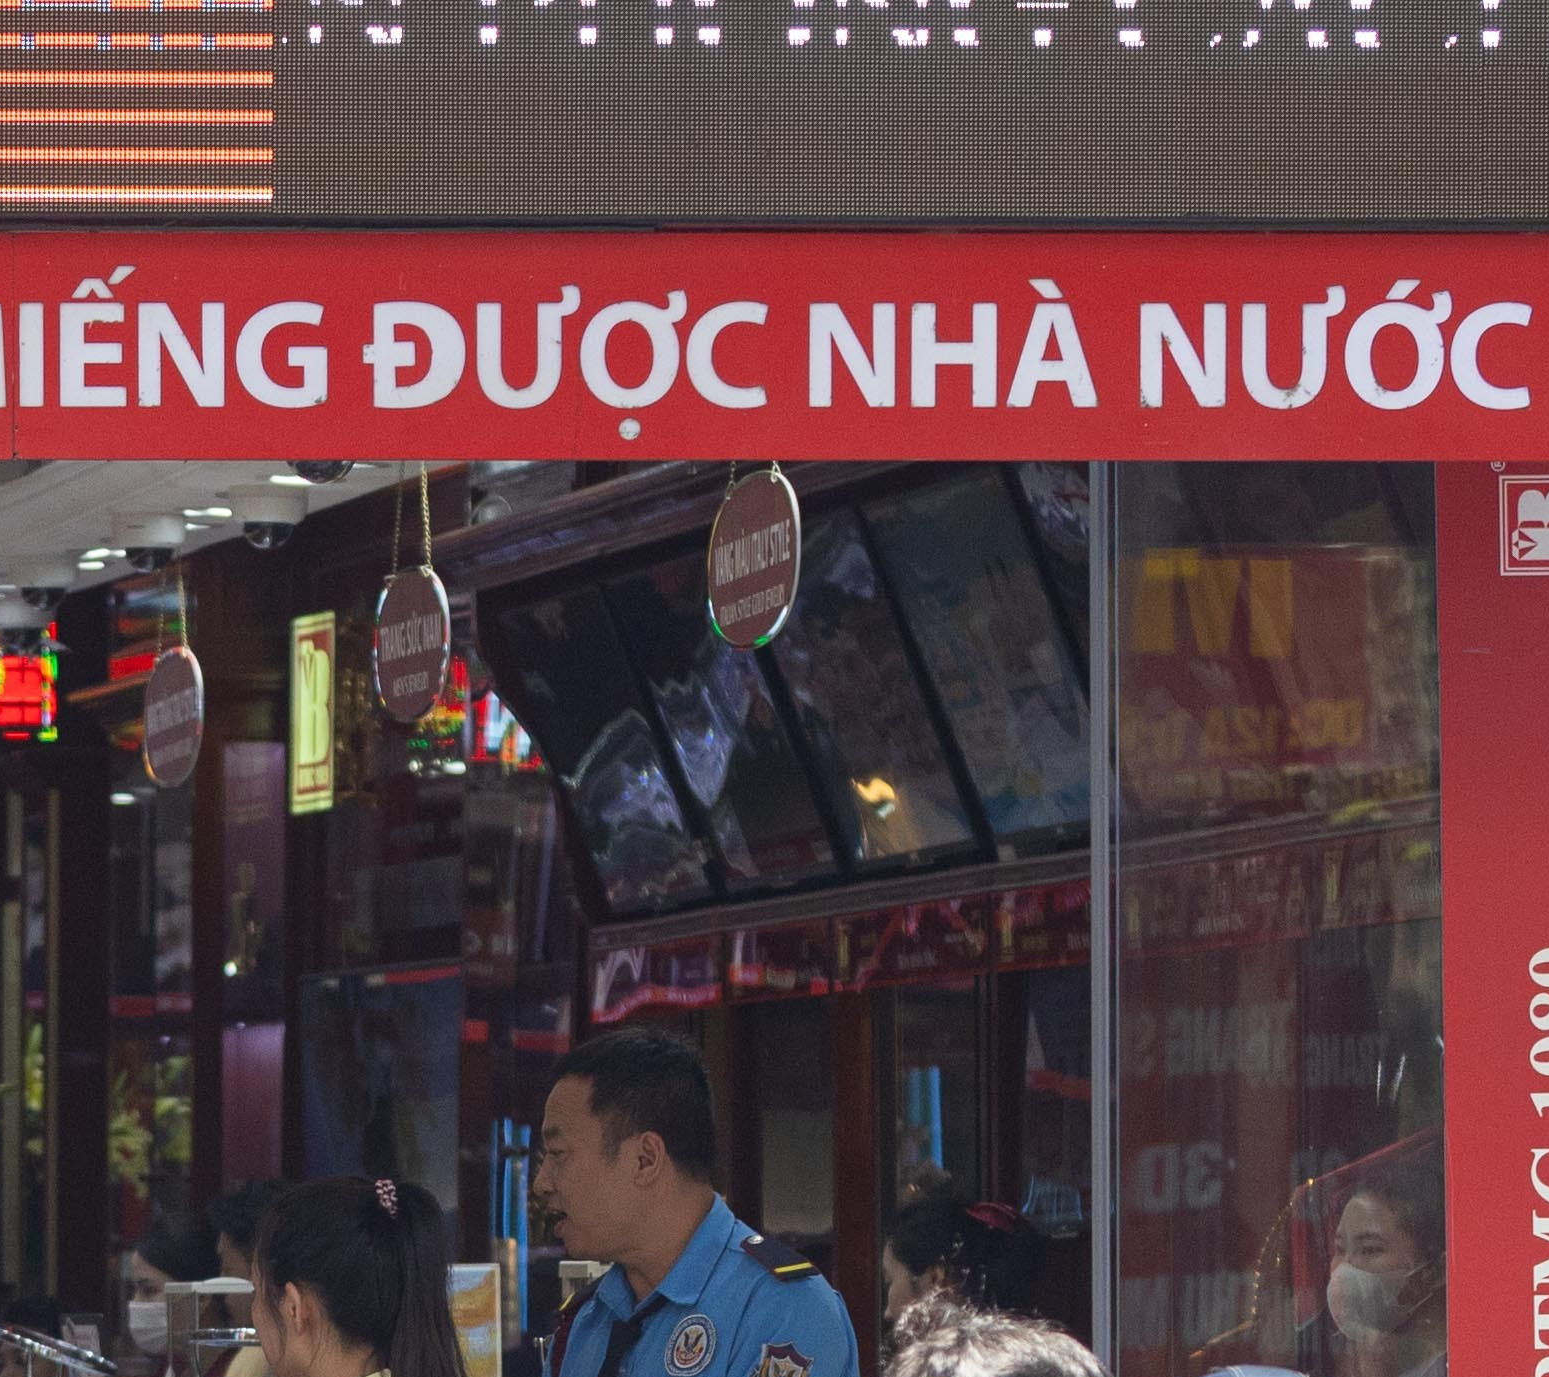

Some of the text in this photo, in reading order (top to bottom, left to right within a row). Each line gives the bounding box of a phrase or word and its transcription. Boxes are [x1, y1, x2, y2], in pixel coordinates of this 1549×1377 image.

[364, 284, 768, 441] ĐƯỢC
[809, 279, 1097, 409] NHÀ
[1141, 278, 1532, 411] NƯỚC
